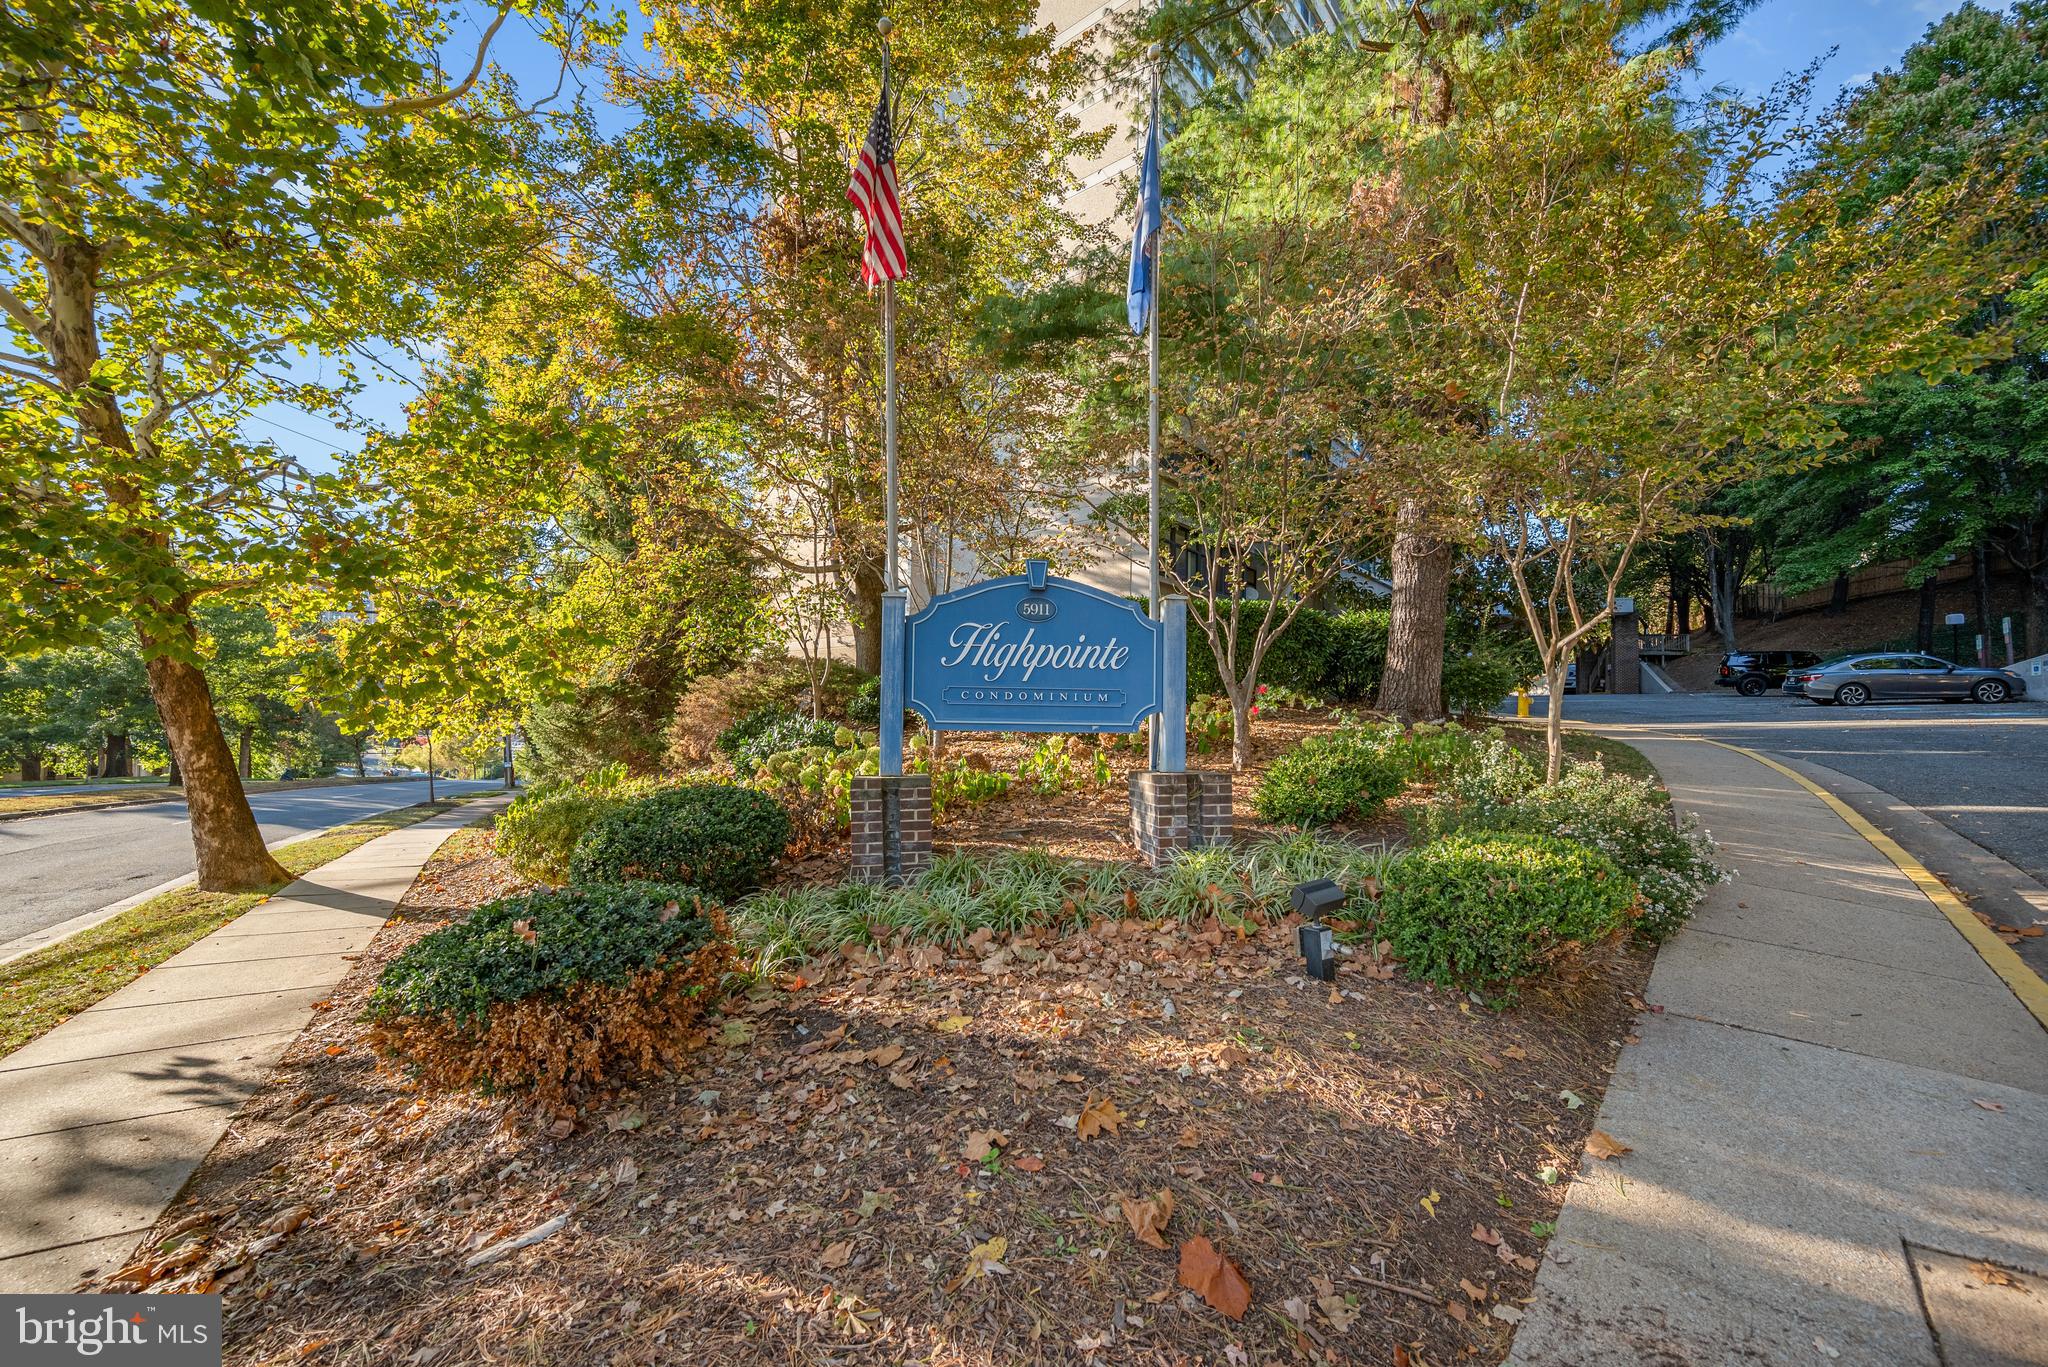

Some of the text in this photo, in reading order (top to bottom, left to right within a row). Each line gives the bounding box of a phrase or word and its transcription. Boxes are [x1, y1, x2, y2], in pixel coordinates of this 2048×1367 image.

[1023, 603, 1050, 616] 5911
[940, 621, 1129, 682] Highpointe
[960, 690, 1109, 702] CONDOMINIUM
